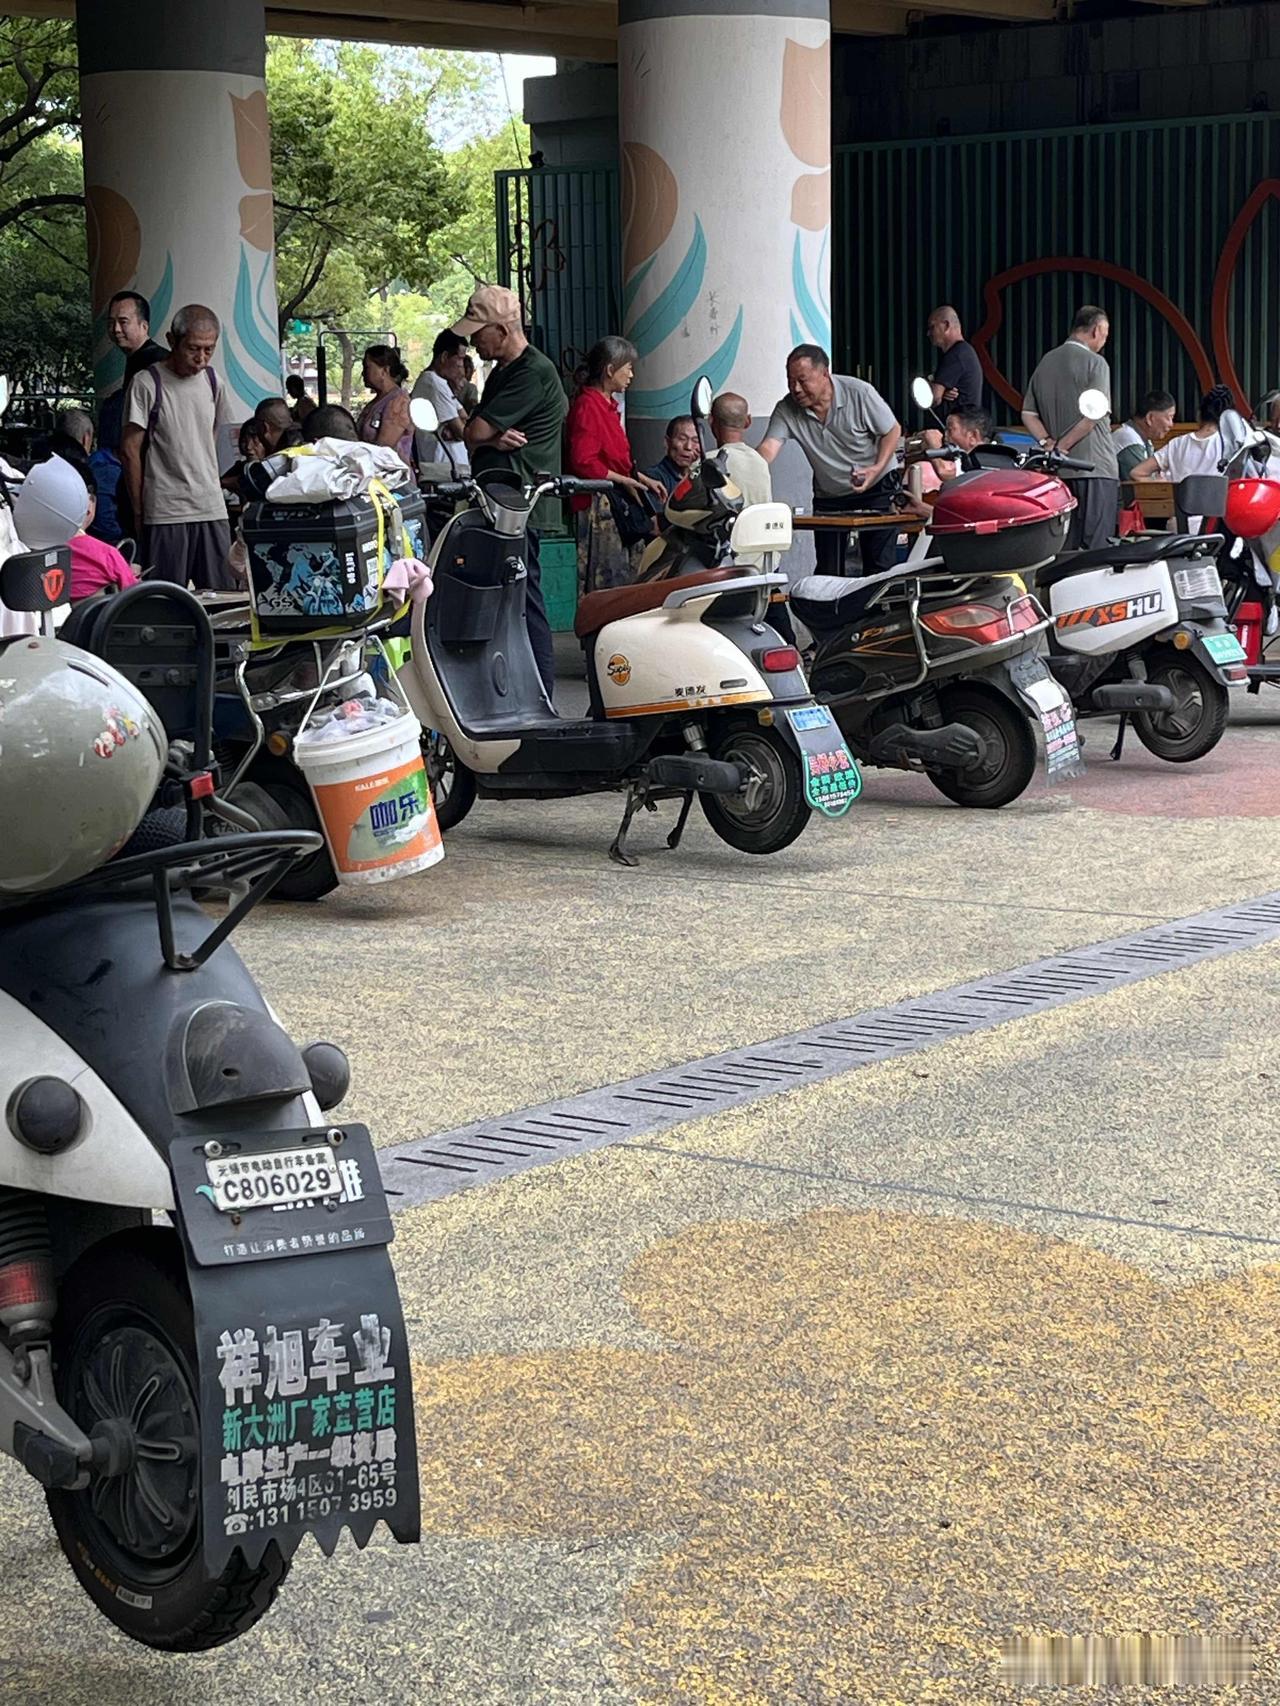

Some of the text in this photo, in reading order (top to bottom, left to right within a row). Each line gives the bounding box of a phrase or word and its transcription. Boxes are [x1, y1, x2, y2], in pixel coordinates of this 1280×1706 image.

[369, 791, 421, 830] 咖乐
[223, 1168, 331, 1203] C806029
[216, 1313, 396, 1406] 祥旭车业
[222, 1384, 397, 1450] 新大洲厂家直营店
[349, 1487, 397, 1513] 3959
